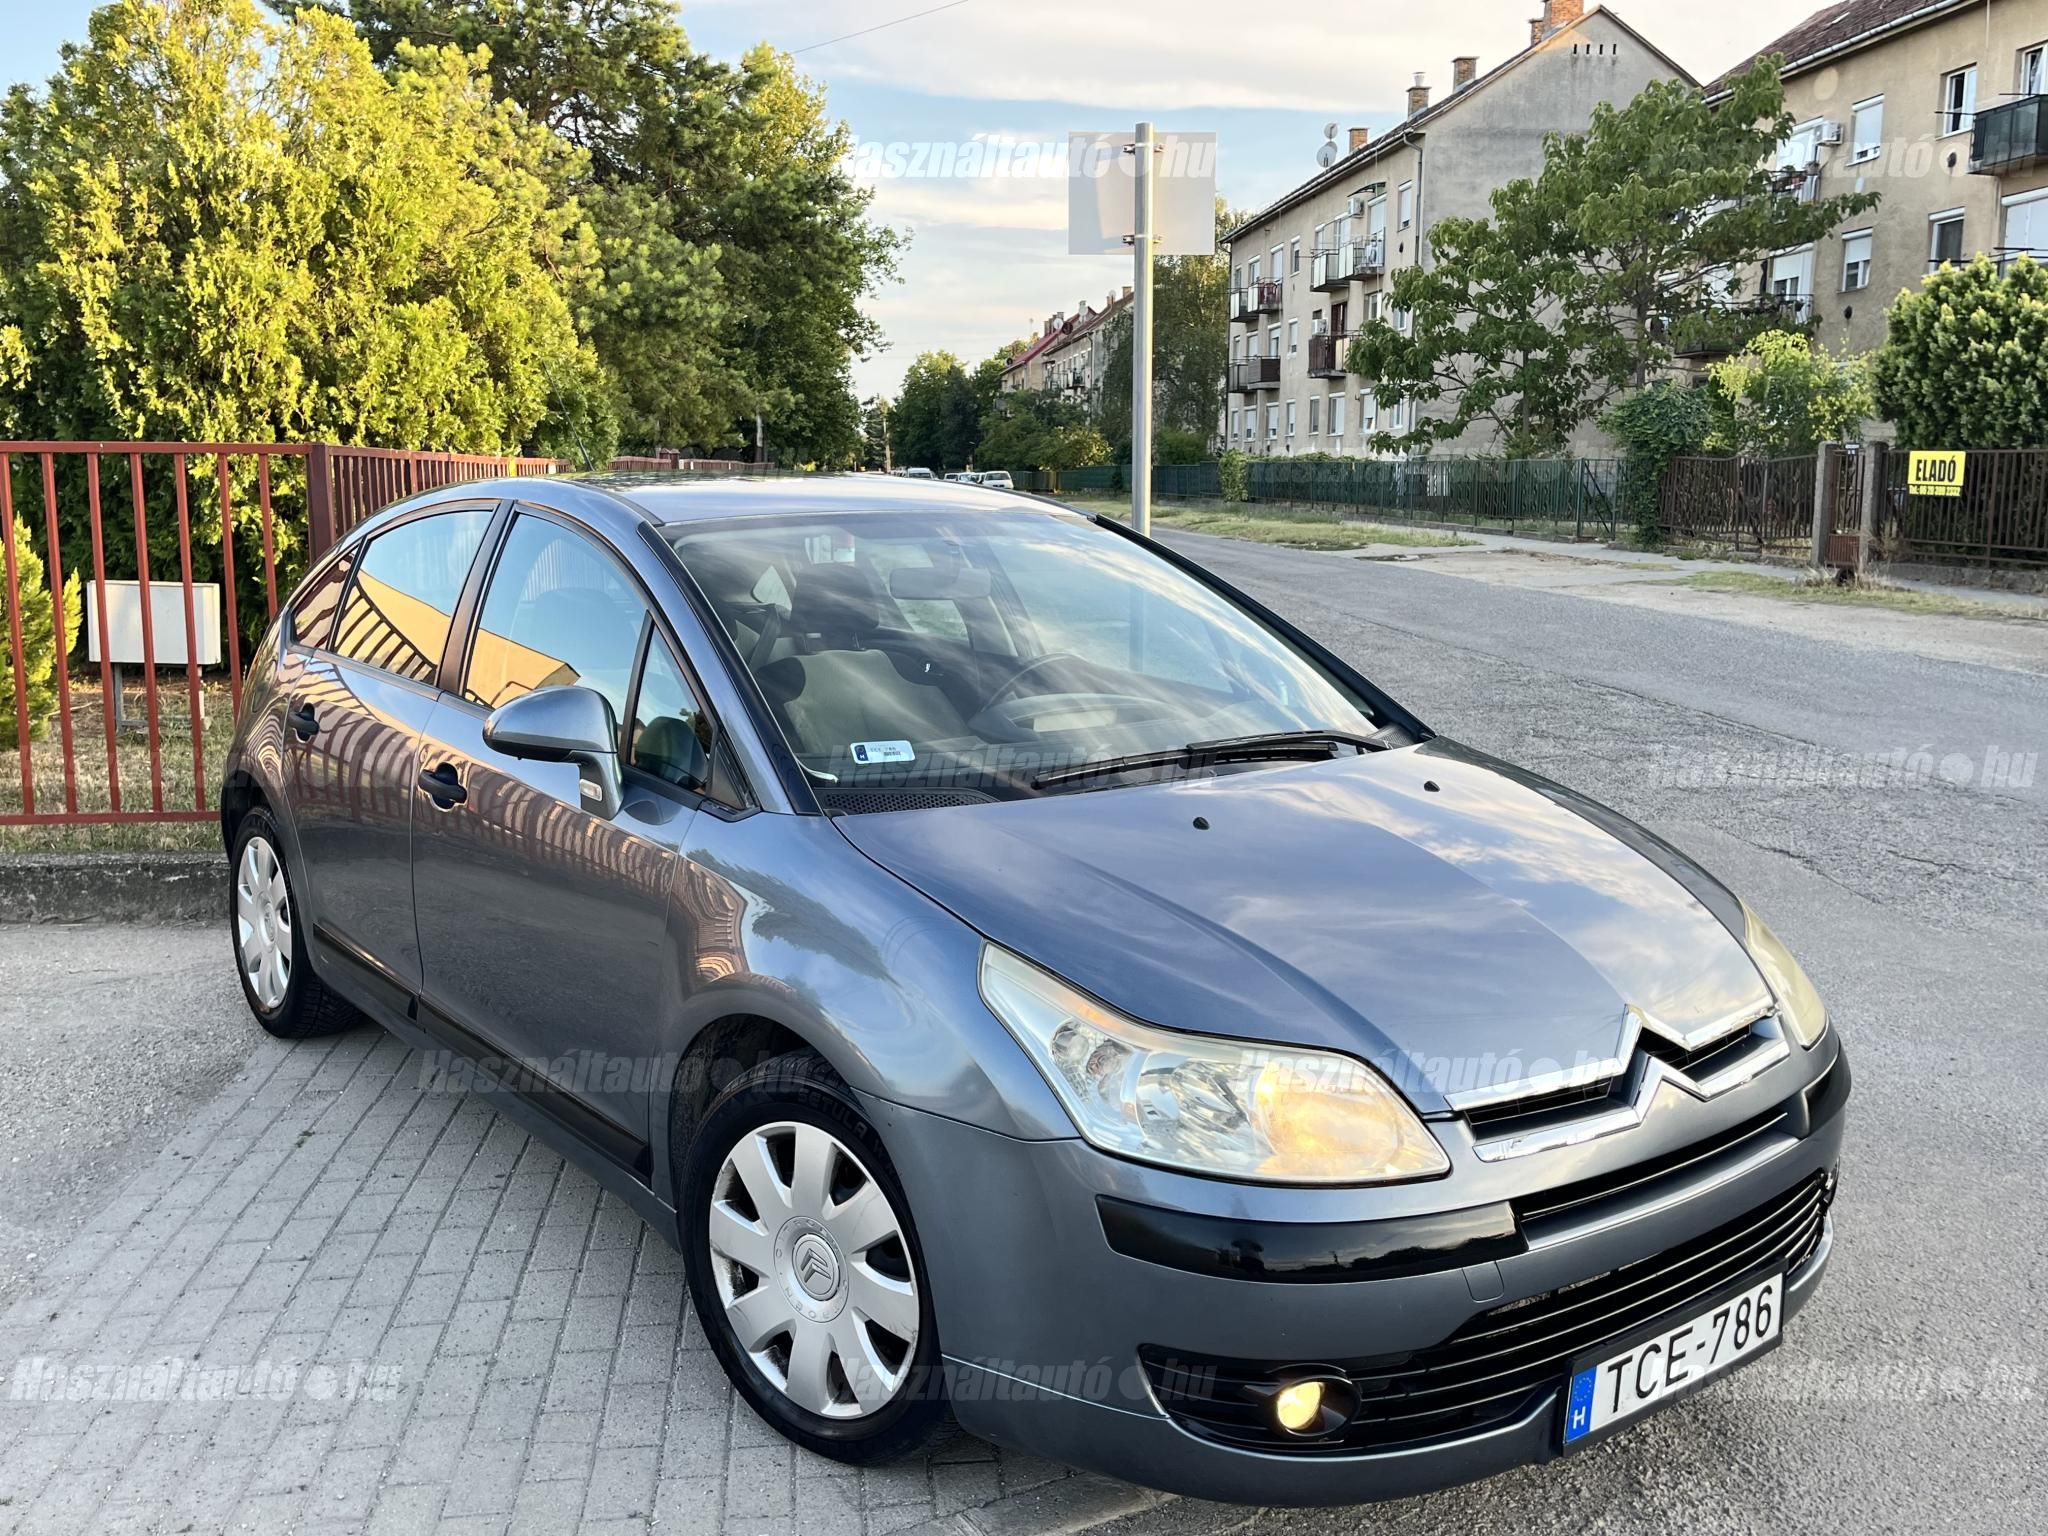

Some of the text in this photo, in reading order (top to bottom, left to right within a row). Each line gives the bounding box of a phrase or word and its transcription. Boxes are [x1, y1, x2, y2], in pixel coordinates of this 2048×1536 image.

[1915, 455, 1957, 482] ELADÓ
[1607, 1284, 1773, 1414] TCE-786
[1571, 1406, 1585, 1429] H
